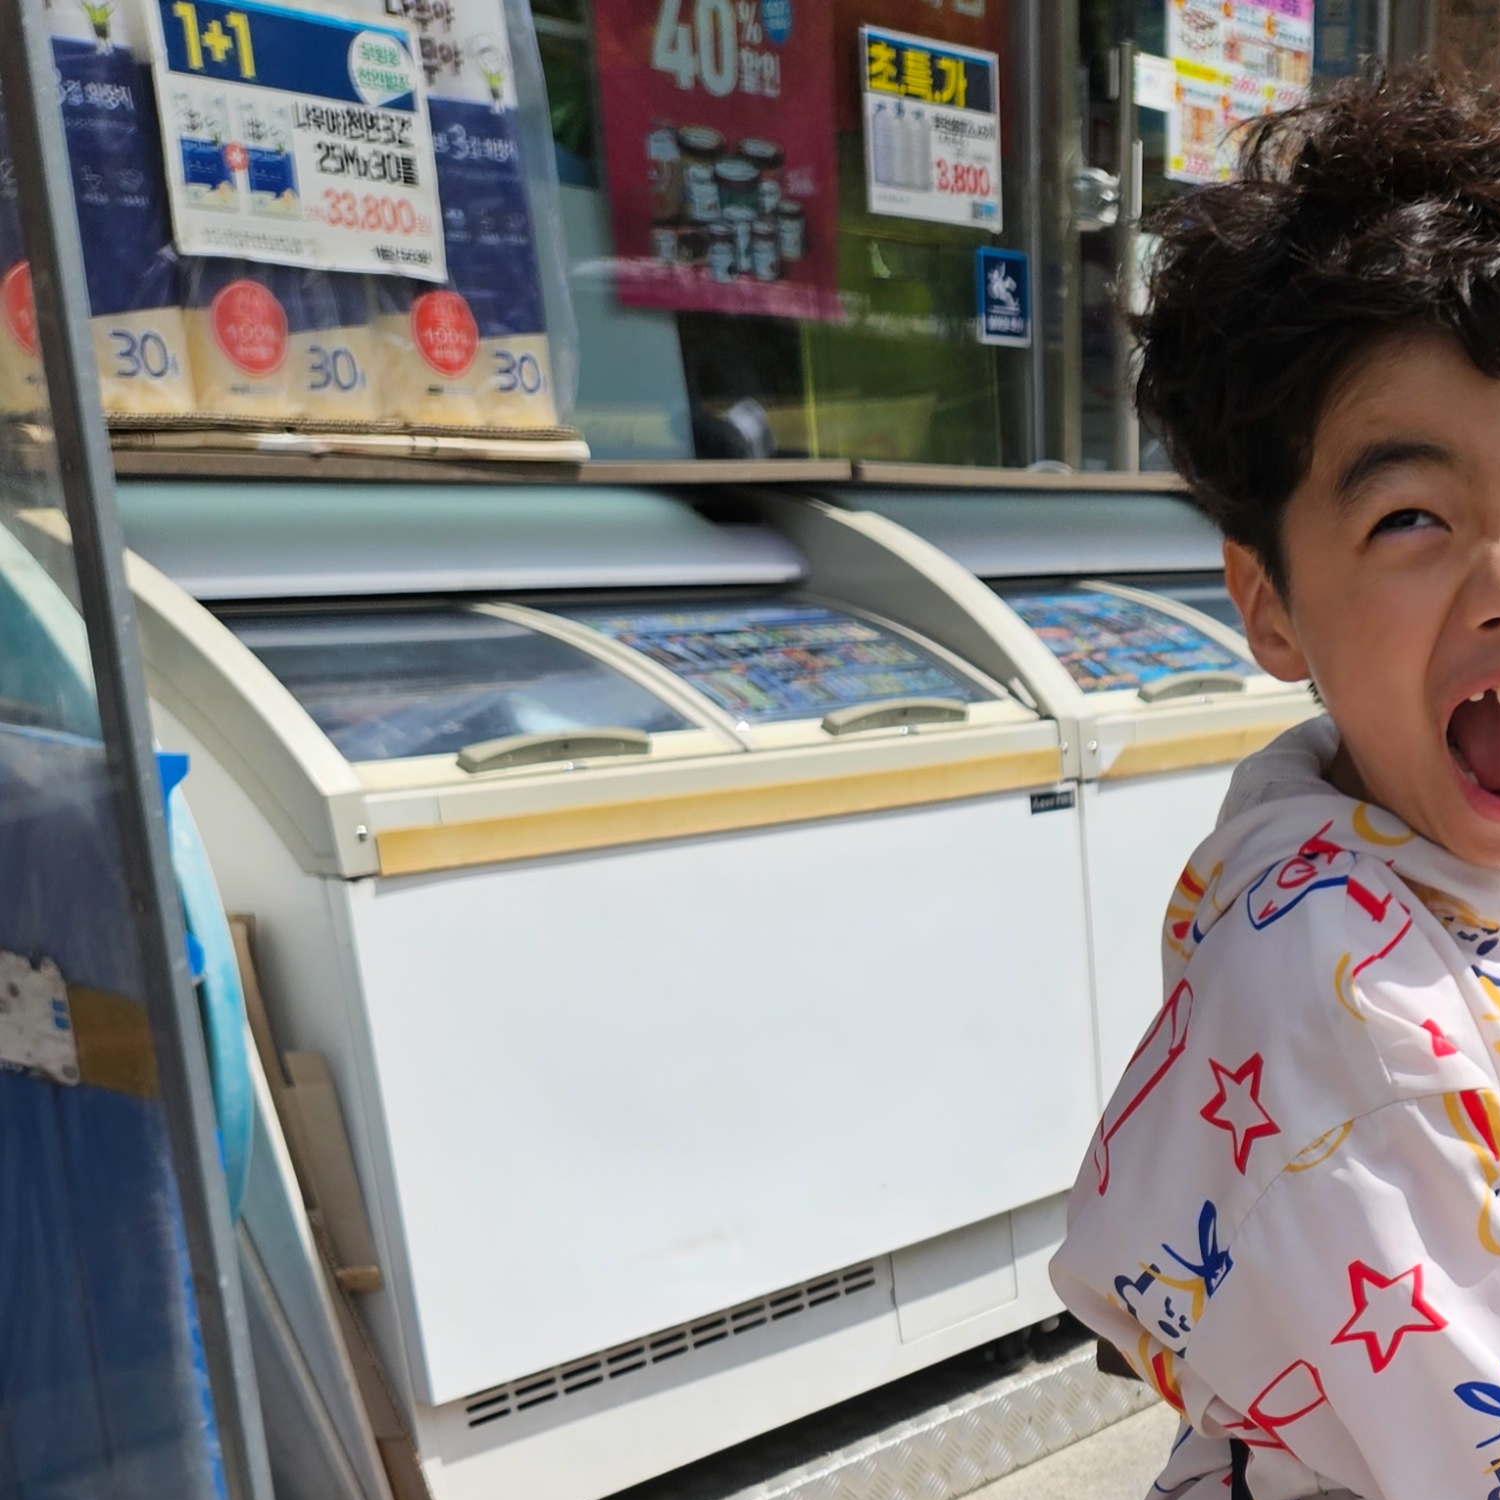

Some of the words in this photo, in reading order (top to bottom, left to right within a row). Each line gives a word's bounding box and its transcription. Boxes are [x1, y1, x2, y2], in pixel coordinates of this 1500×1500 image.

[173, 2, 256, 79] 1+1
[867, 41, 968, 109] 초특가
[936, 158, 992, 198] 3,800
